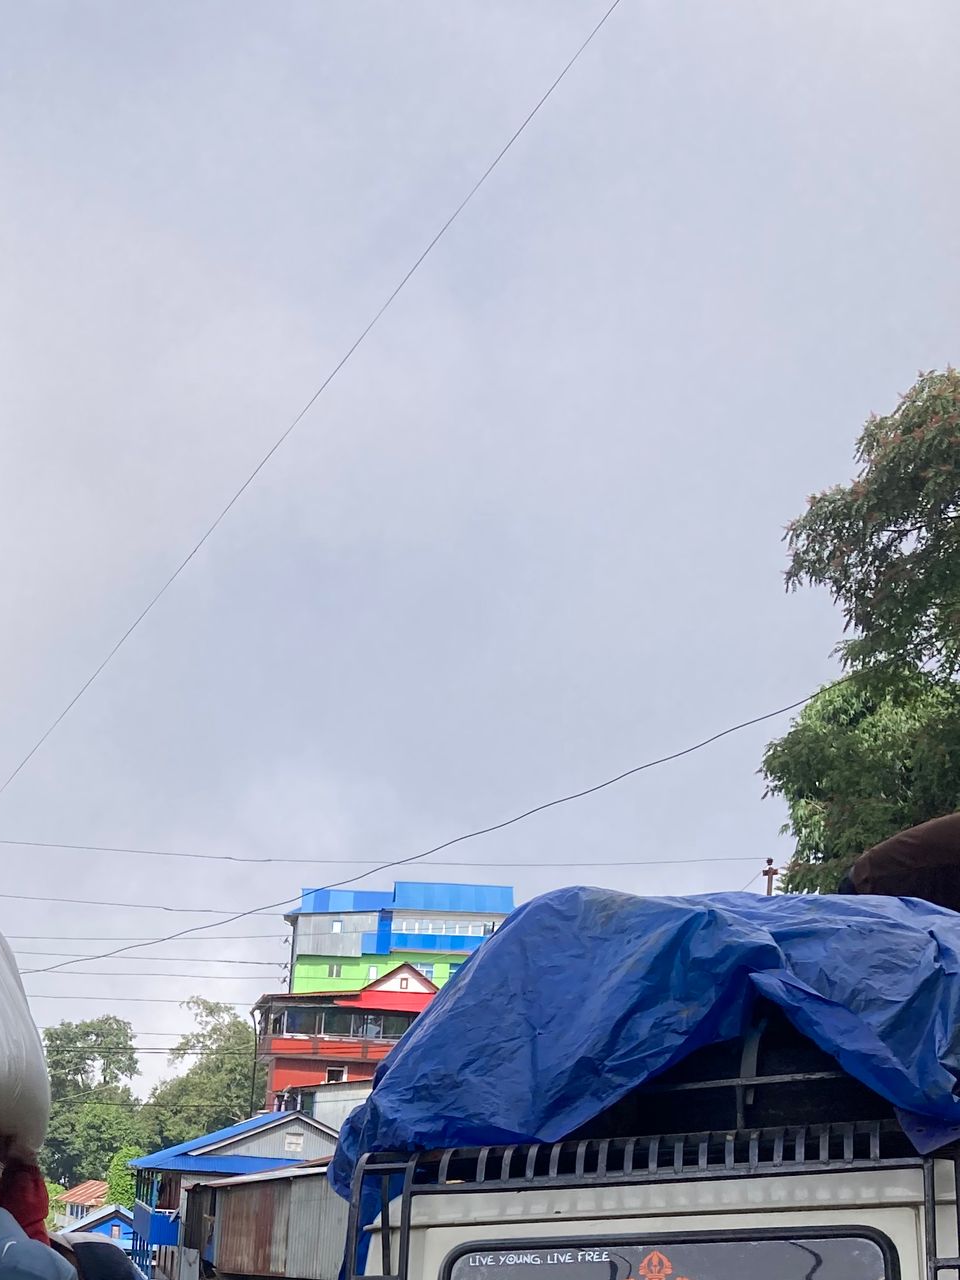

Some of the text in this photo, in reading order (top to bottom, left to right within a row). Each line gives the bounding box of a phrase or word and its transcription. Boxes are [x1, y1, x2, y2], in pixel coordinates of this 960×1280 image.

[469, 1255, 495, 1266] LIVE
[547, 1253, 574, 1263] LIVE
[577, 1251, 610, 1262] FREE
